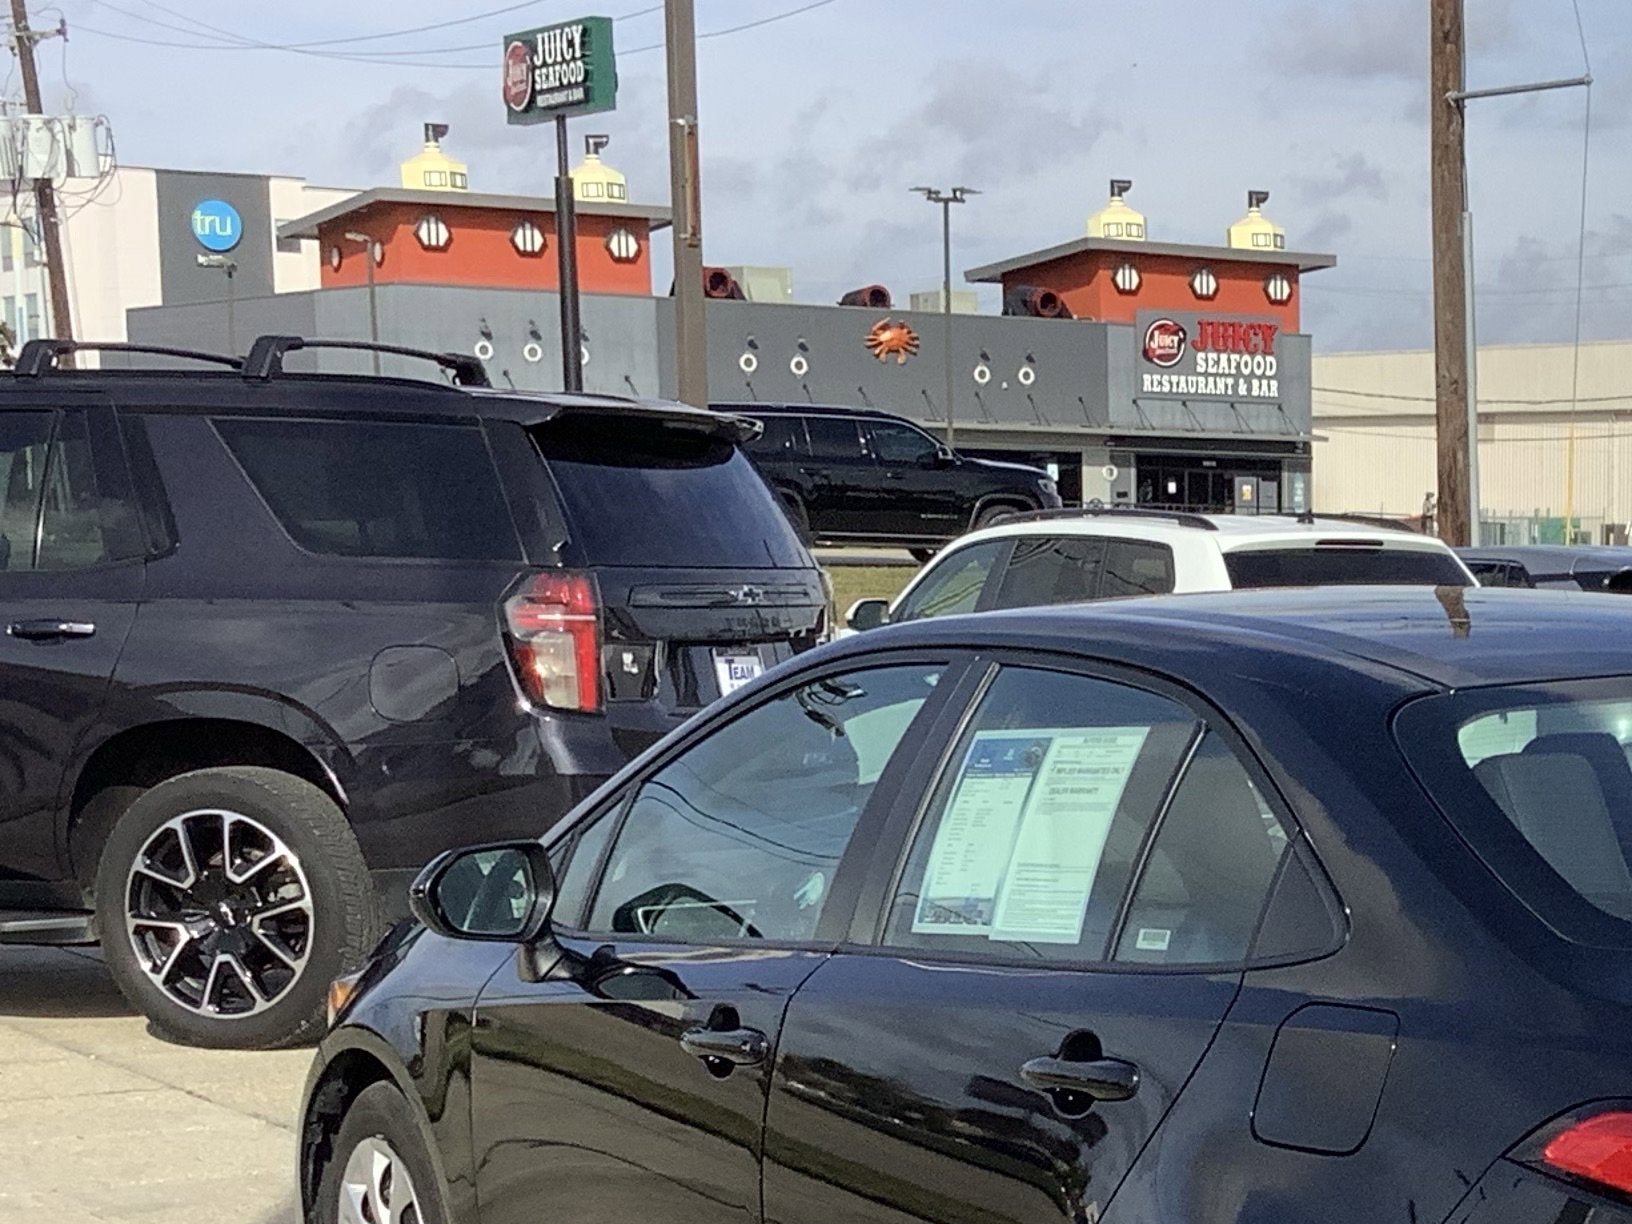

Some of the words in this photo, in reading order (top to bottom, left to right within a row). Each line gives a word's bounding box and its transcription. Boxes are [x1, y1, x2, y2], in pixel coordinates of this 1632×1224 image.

[533, 24, 584, 66] JUICY
[534, 60, 585, 91] SEAFOOD
[192, 209, 233, 236] tru
[1190, 319, 1279, 355] JUICY
[1195, 352, 1278, 377] SEAFOOD
[1142, 373, 1235, 395] RESTAURANT
[1237, 377, 1248, 396] &
[1251, 378, 1280, 398] BAR
